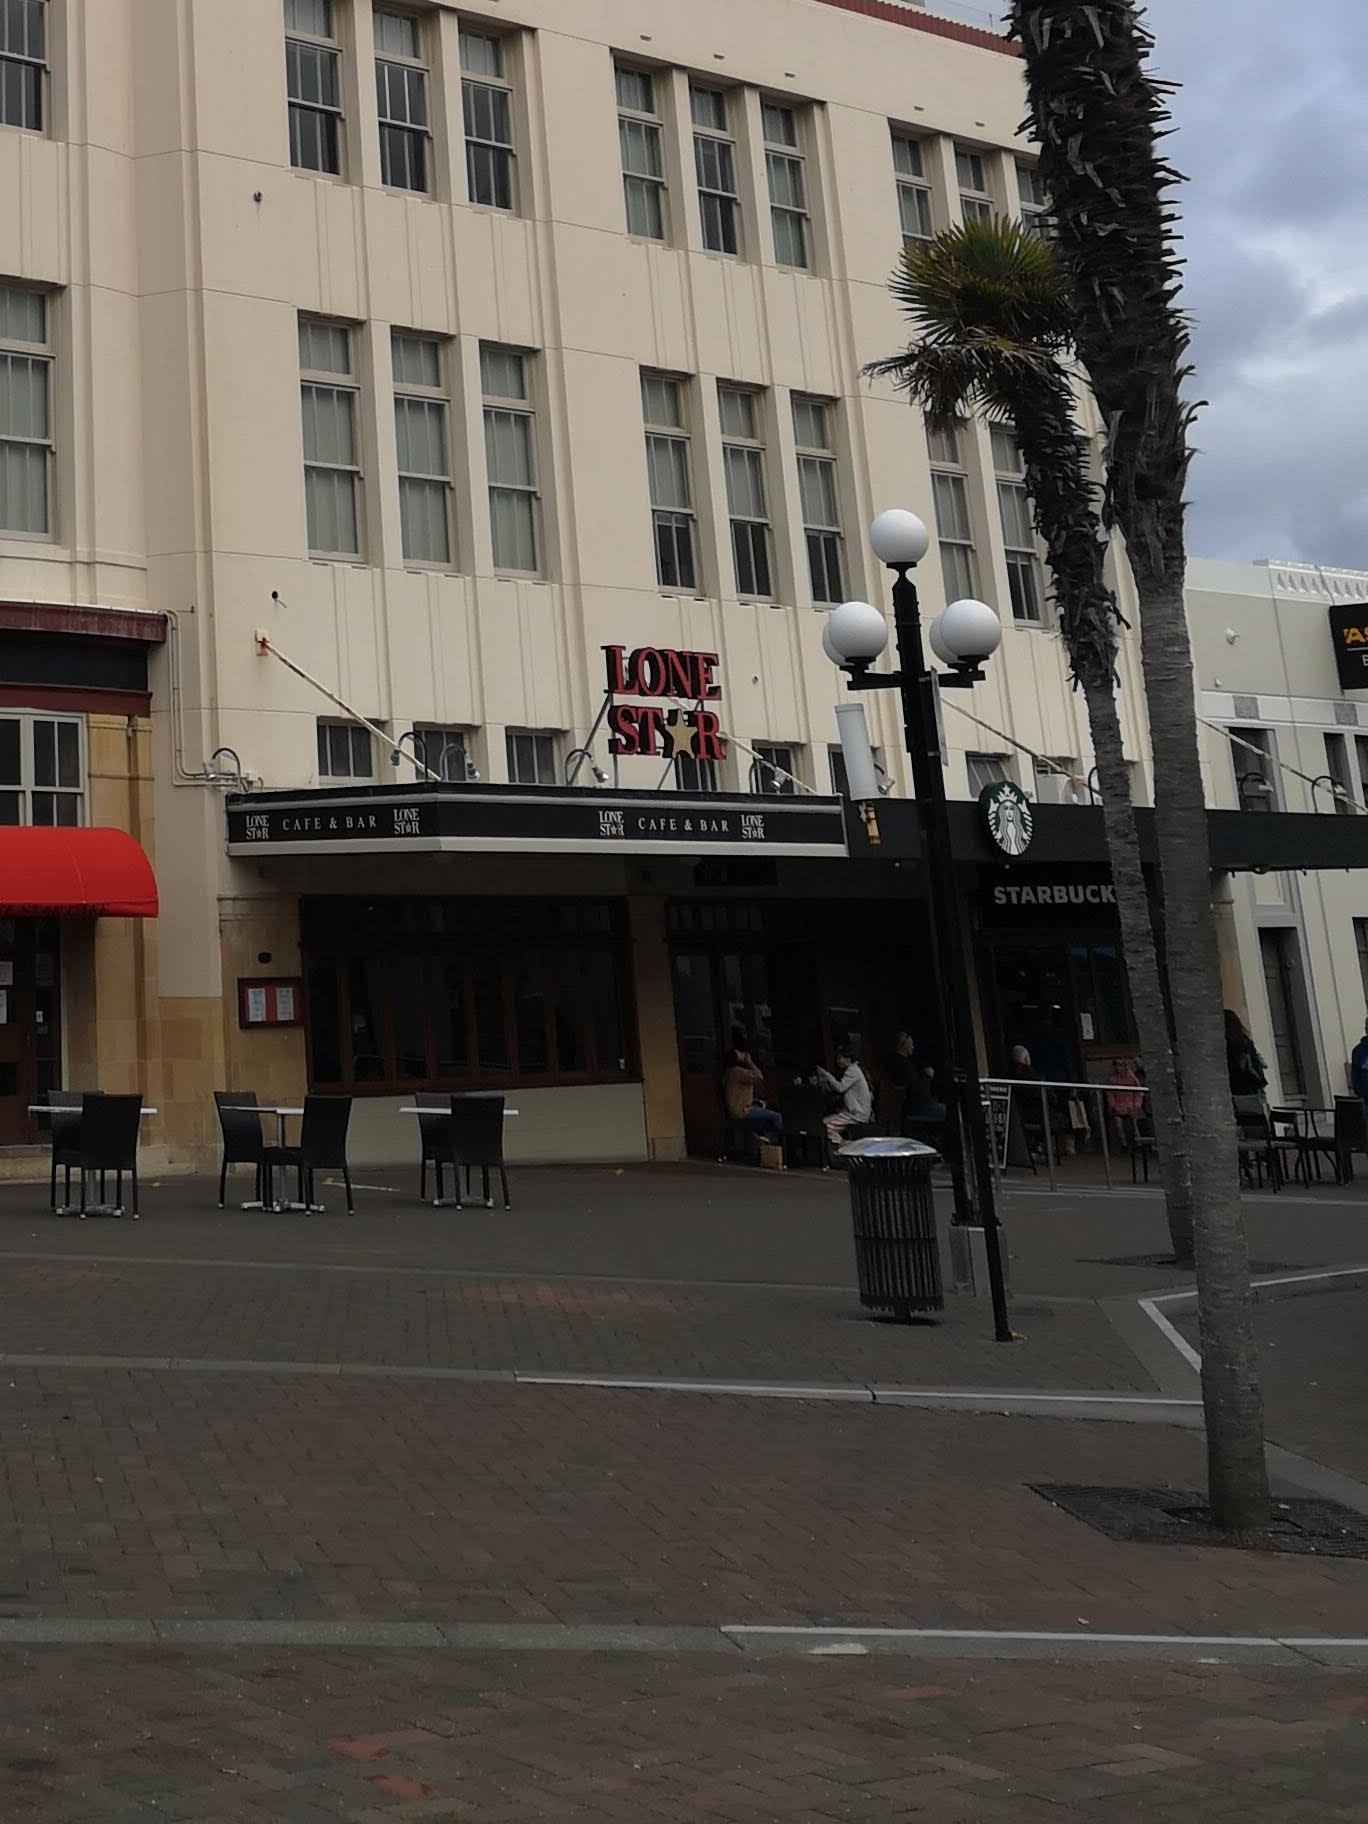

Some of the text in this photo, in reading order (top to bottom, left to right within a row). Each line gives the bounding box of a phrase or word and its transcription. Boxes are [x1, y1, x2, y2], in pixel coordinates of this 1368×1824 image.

[601, 645, 722, 700] LONE
[245, 814, 269, 827] LONE
[393, 808, 420, 821] LONE
[599, 810, 624, 823] LONE
[740, 814, 765, 827] LONE
[282, 815, 377, 831] CAFE & BAR
[638, 817, 729, 832] CAFE & BAR
[994, 884, 1117, 904] STARBUCK
